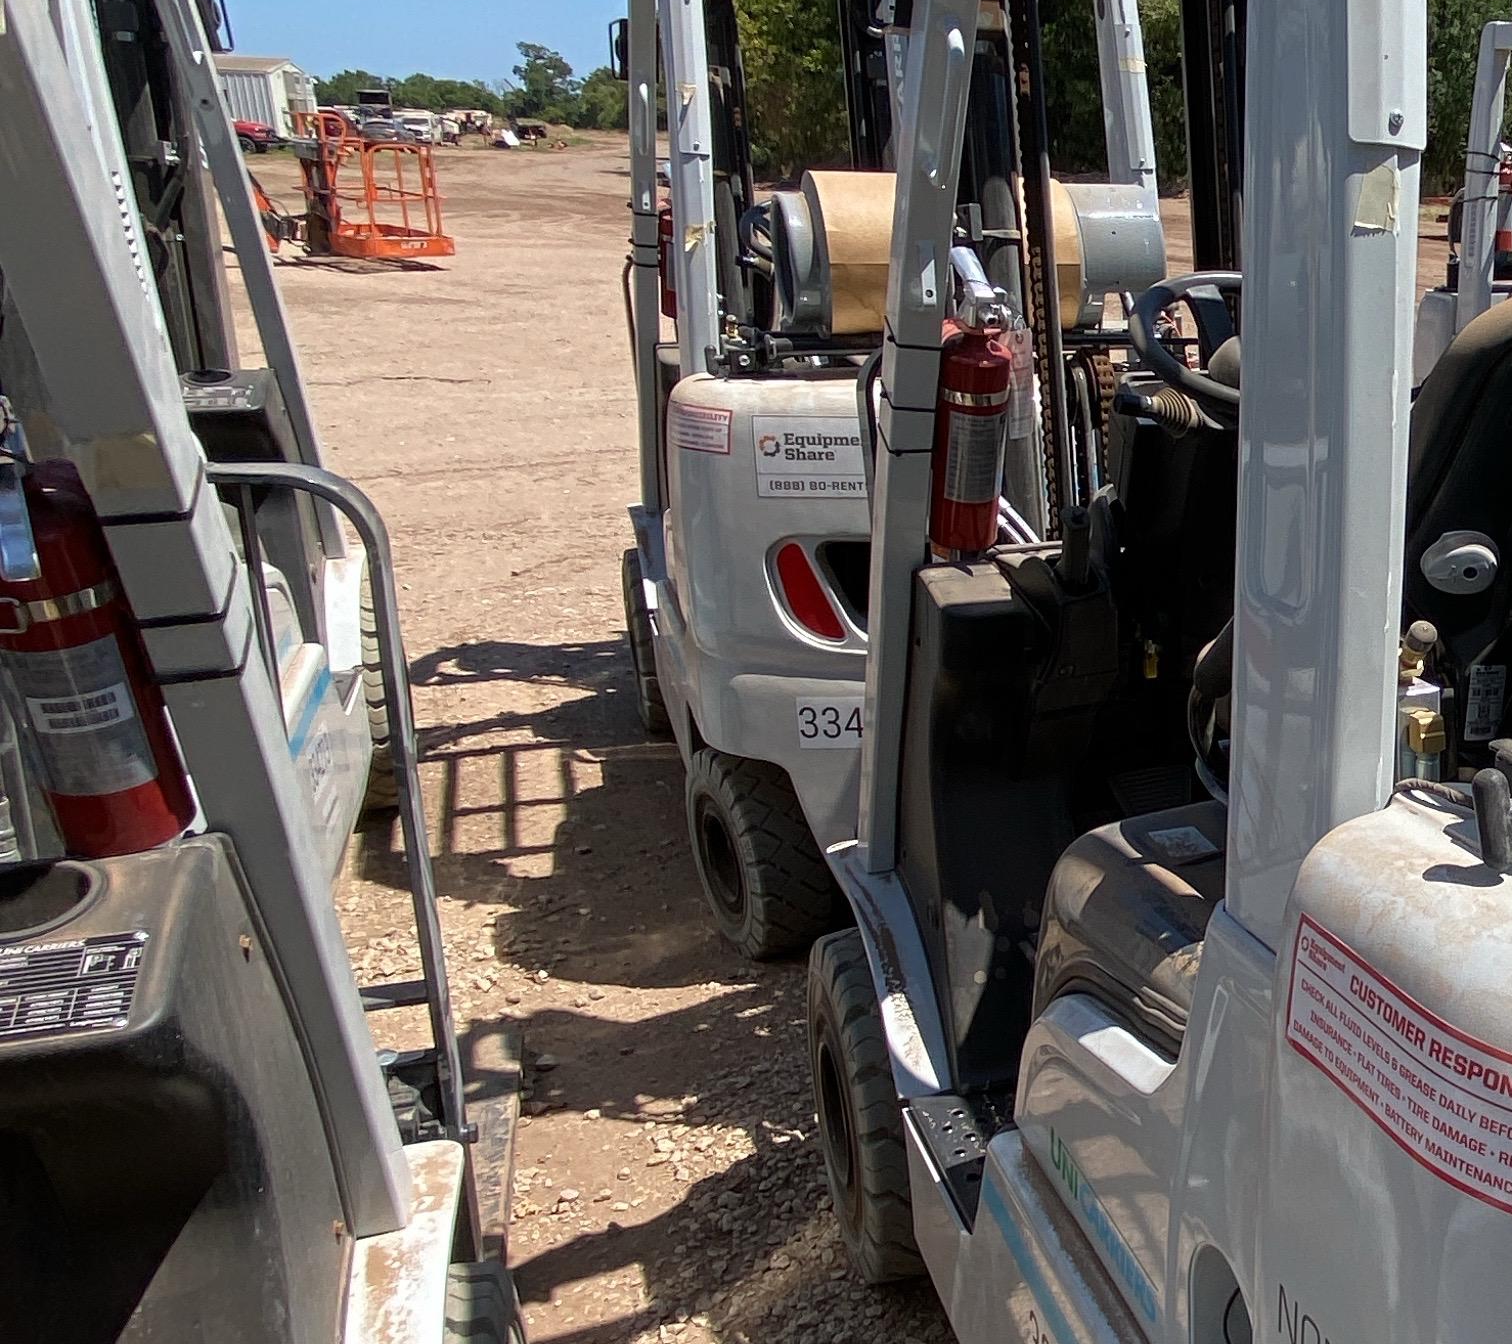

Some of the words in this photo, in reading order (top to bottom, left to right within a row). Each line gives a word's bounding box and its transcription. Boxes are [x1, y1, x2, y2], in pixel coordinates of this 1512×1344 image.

[783, 433, 862, 449] Equipme
[784, 448, 835, 461] Share
[769, 480, 805, 492] (888)
[808, 480, 865, 492] 80-RENT
[799, 706, 864, 739] 334
[1349, 974, 1427, 1052] CUSTOMER
[1301, 978, 1326, 1008] CHECK
[1326, 1000, 1339, 1019] ALL
[1339, 1010, 1362, 1039] FLUID
[1362, 1028, 1391, 1065] LEVELS
[1399, 1064, 1437, 1102] GREASE
[1438, 1093, 1477, 1123] DAILY
[1293, 1019, 1323, 1055] DAMAGE
[1324, 1046, 1334, 1064] TO
[1334, 1056, 1381, 1105] EQUIPMENT
[1384, 1103, 1424, 1145] BATTERY
[1310, 1009, 1353, 1056] INSURANCE
[1357, 1053, 1376, 1077] FLAT
[1376, 1068, 1401, 1100] TIRES
[1406, 1096, 1429, 1123] TIRE
[1431, 1117, 1488, 1156] DAMAGE
